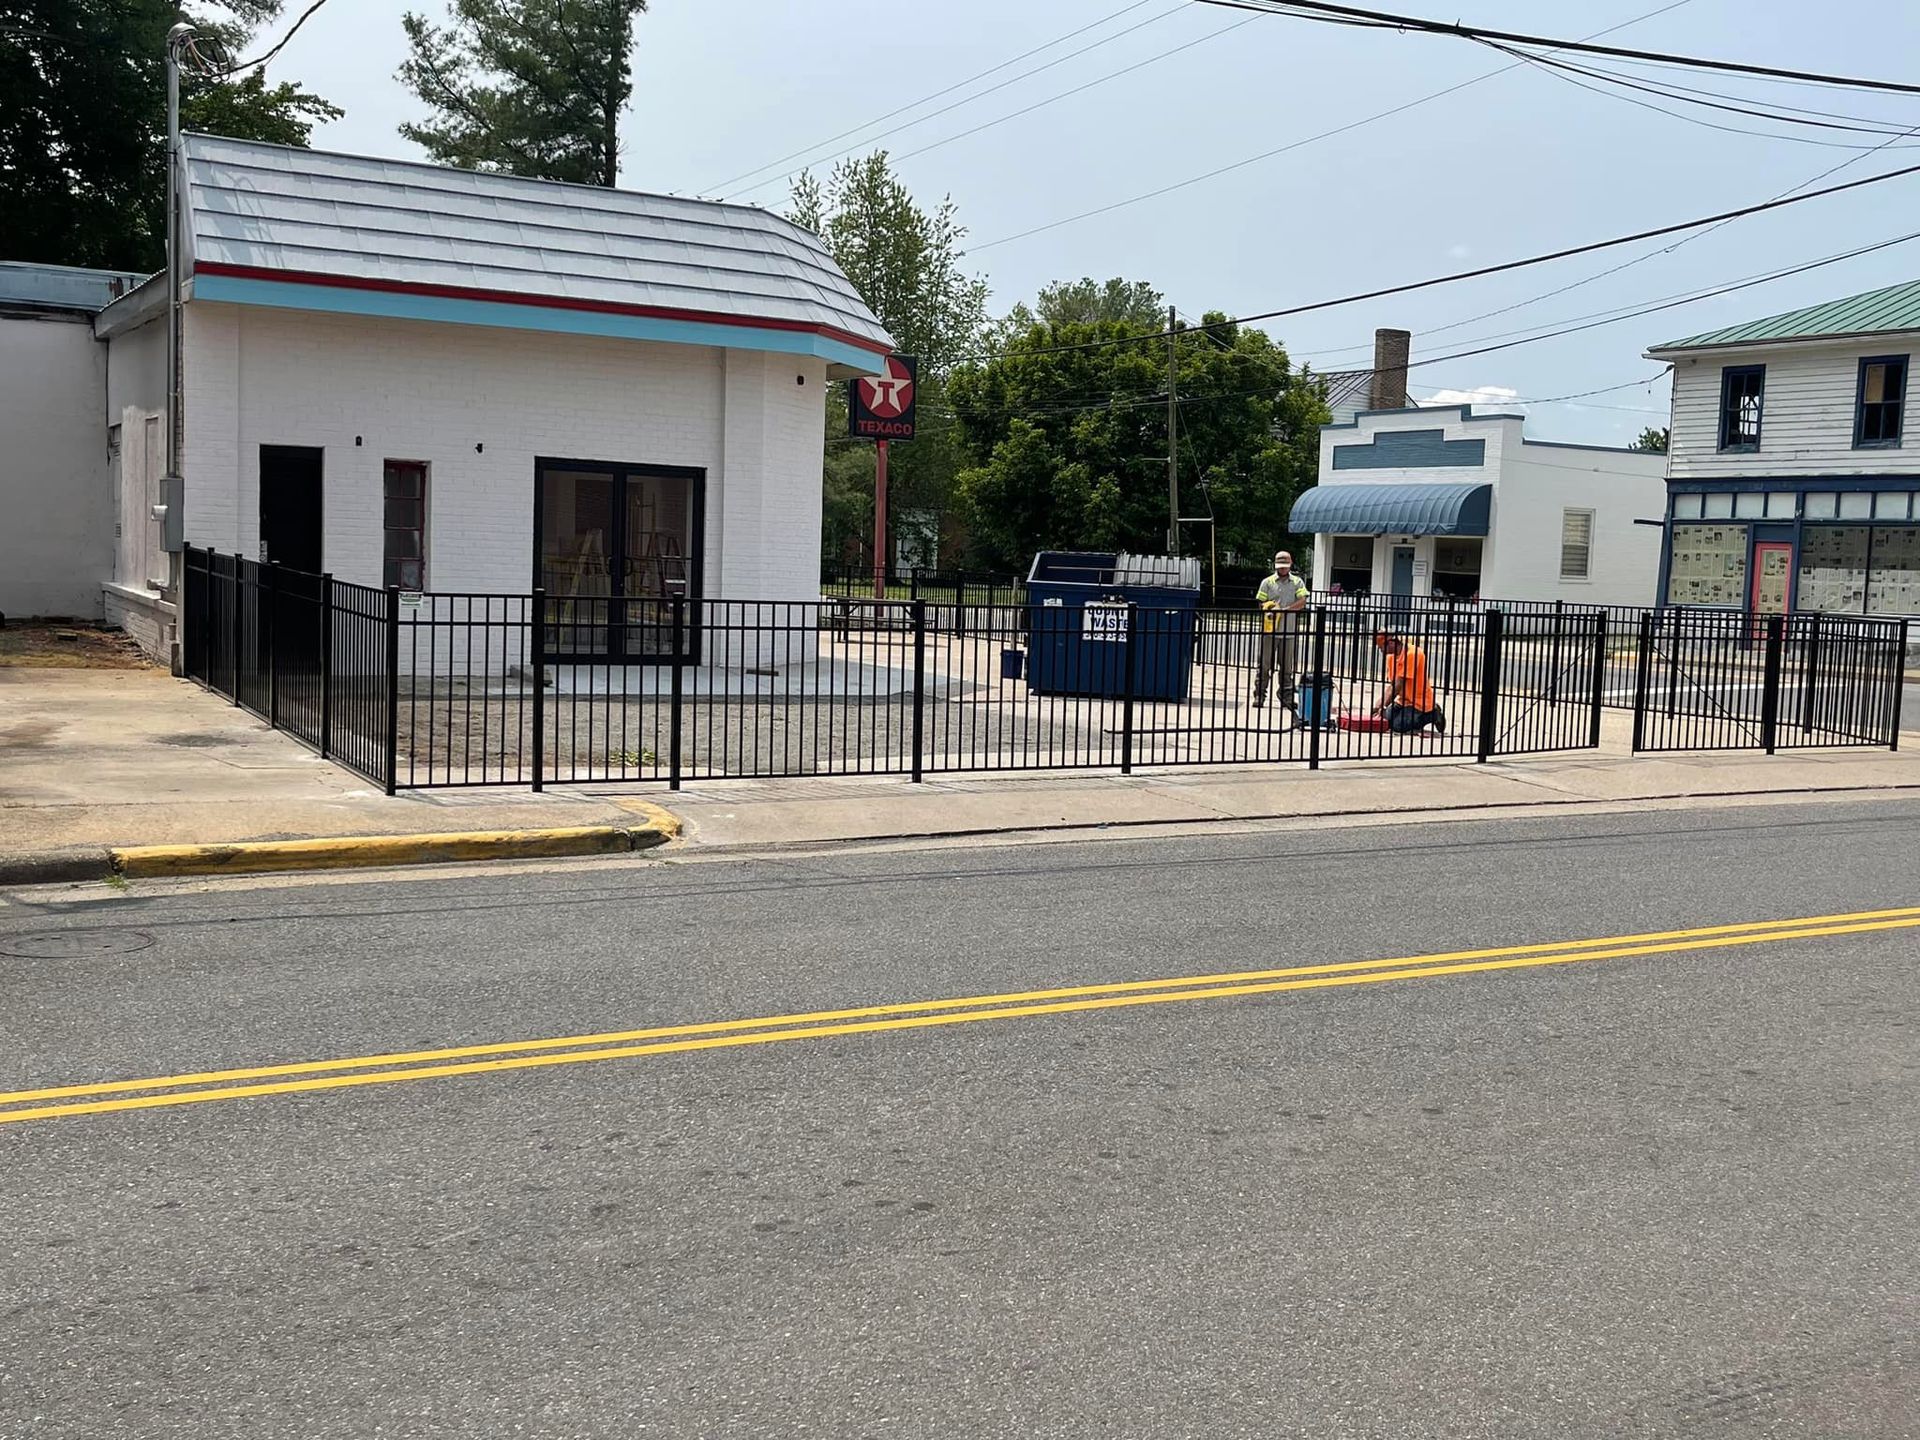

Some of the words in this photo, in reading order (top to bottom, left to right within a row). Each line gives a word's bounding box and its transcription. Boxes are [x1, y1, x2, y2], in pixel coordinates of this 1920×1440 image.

[858, 420, 913, 435] TEXACO
[1087, 605, 1128, 617] COUNT
[1091, 618, 1129, 629] WASTE
